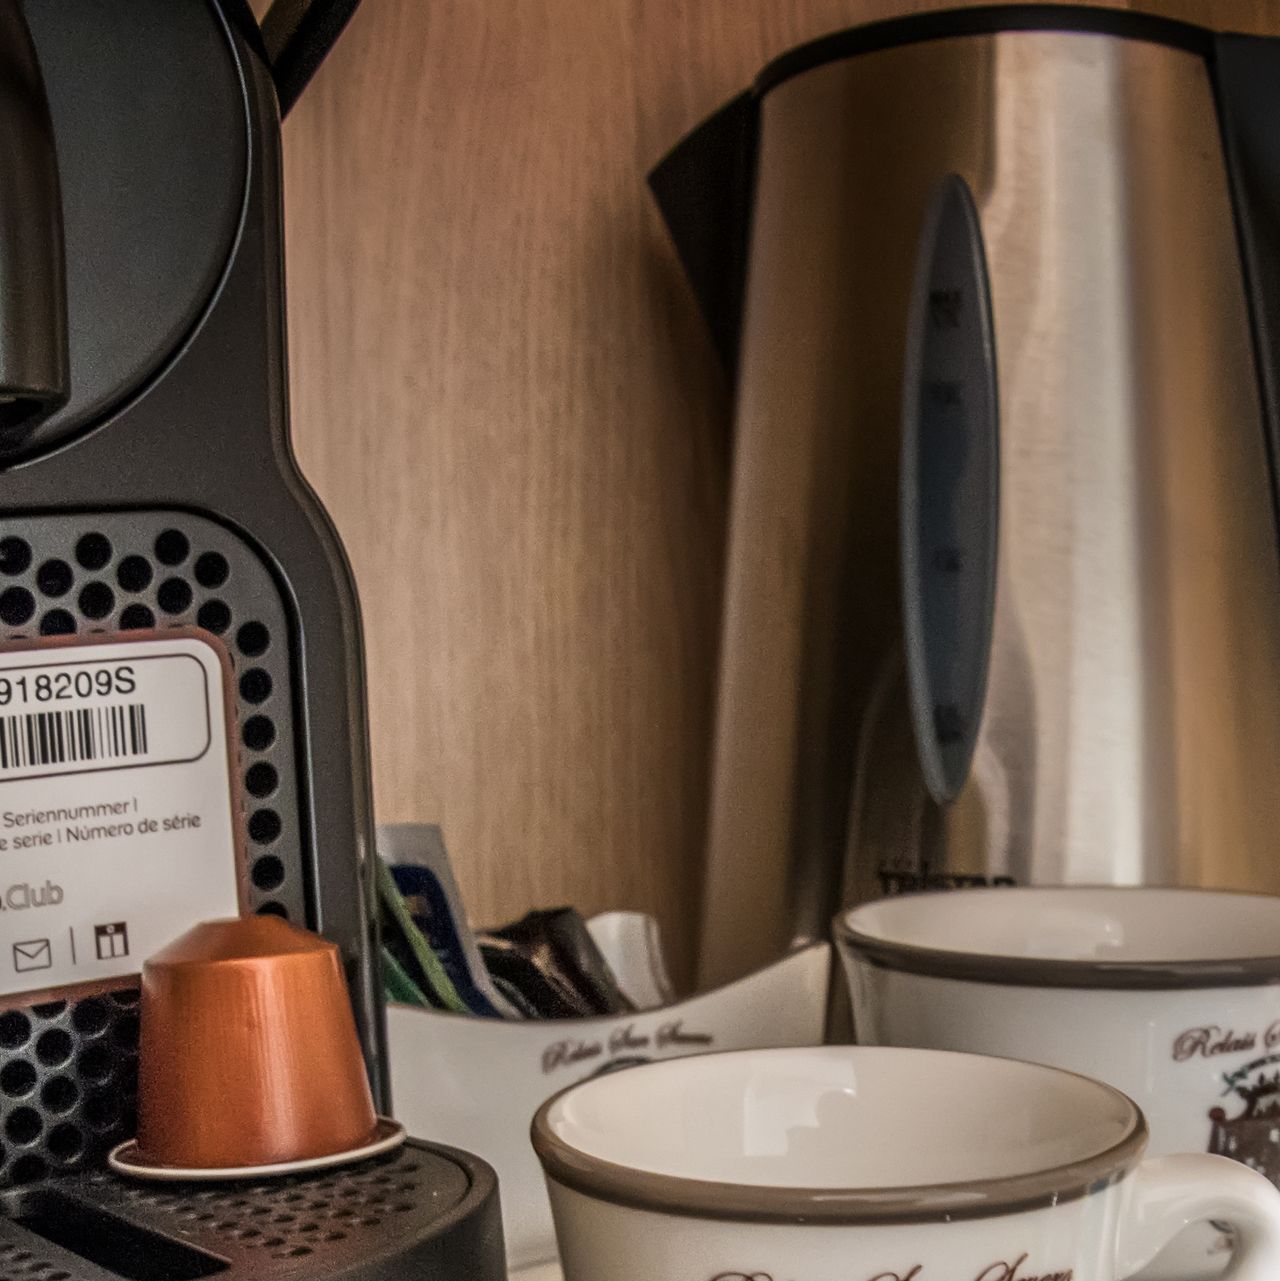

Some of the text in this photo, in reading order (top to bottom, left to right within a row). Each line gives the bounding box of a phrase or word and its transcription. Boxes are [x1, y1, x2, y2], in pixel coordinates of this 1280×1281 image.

[3, 799, 130, 828] Seriennummer
[12, 831, 54, 851] serie
[66, 821, 135, 844] Número
[137, 817, 159, 835] de
[162, 812, 202, 832] série
